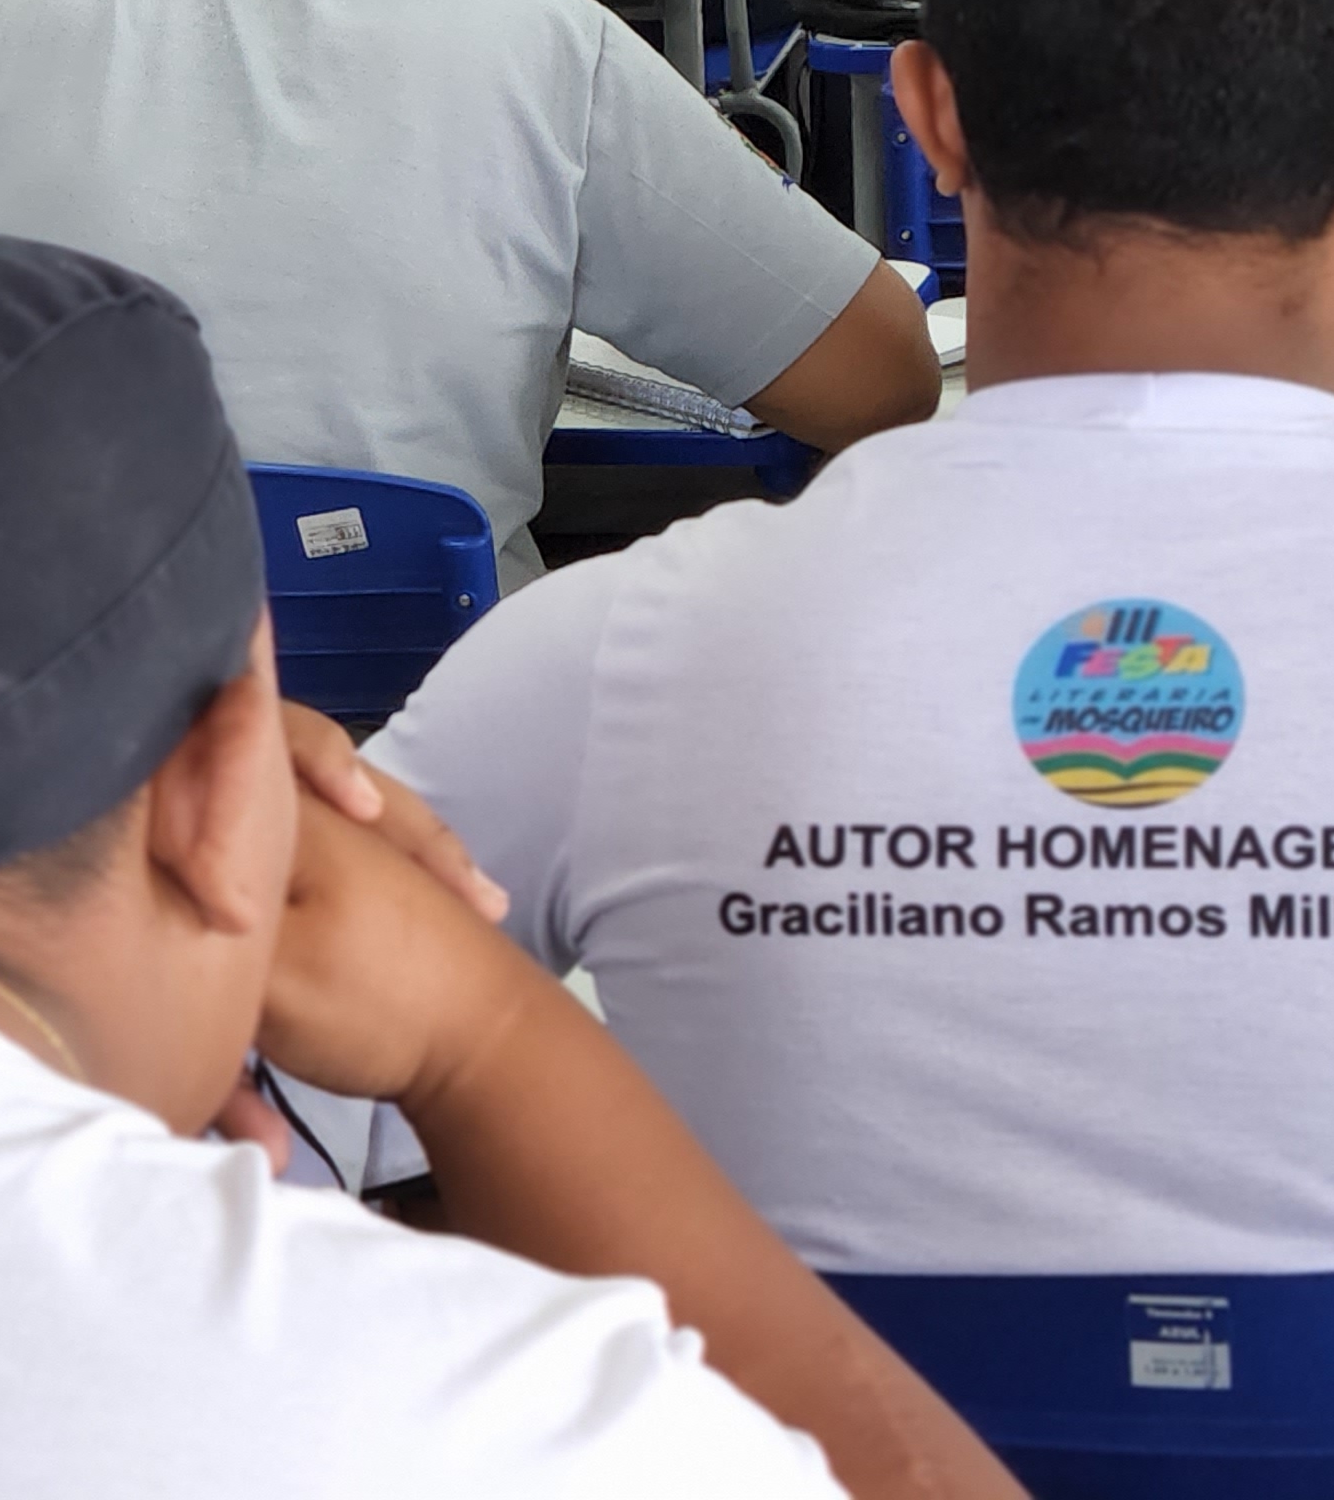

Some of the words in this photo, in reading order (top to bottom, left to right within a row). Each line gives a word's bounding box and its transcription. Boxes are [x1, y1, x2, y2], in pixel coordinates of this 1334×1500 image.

[1055, 635, 1211, 680] FESTA
[764, 824, 976, 869] AUTOR
[719, 893, 1005, 938] Graciliano
[1025, 893, 1226, 938] Ramos
